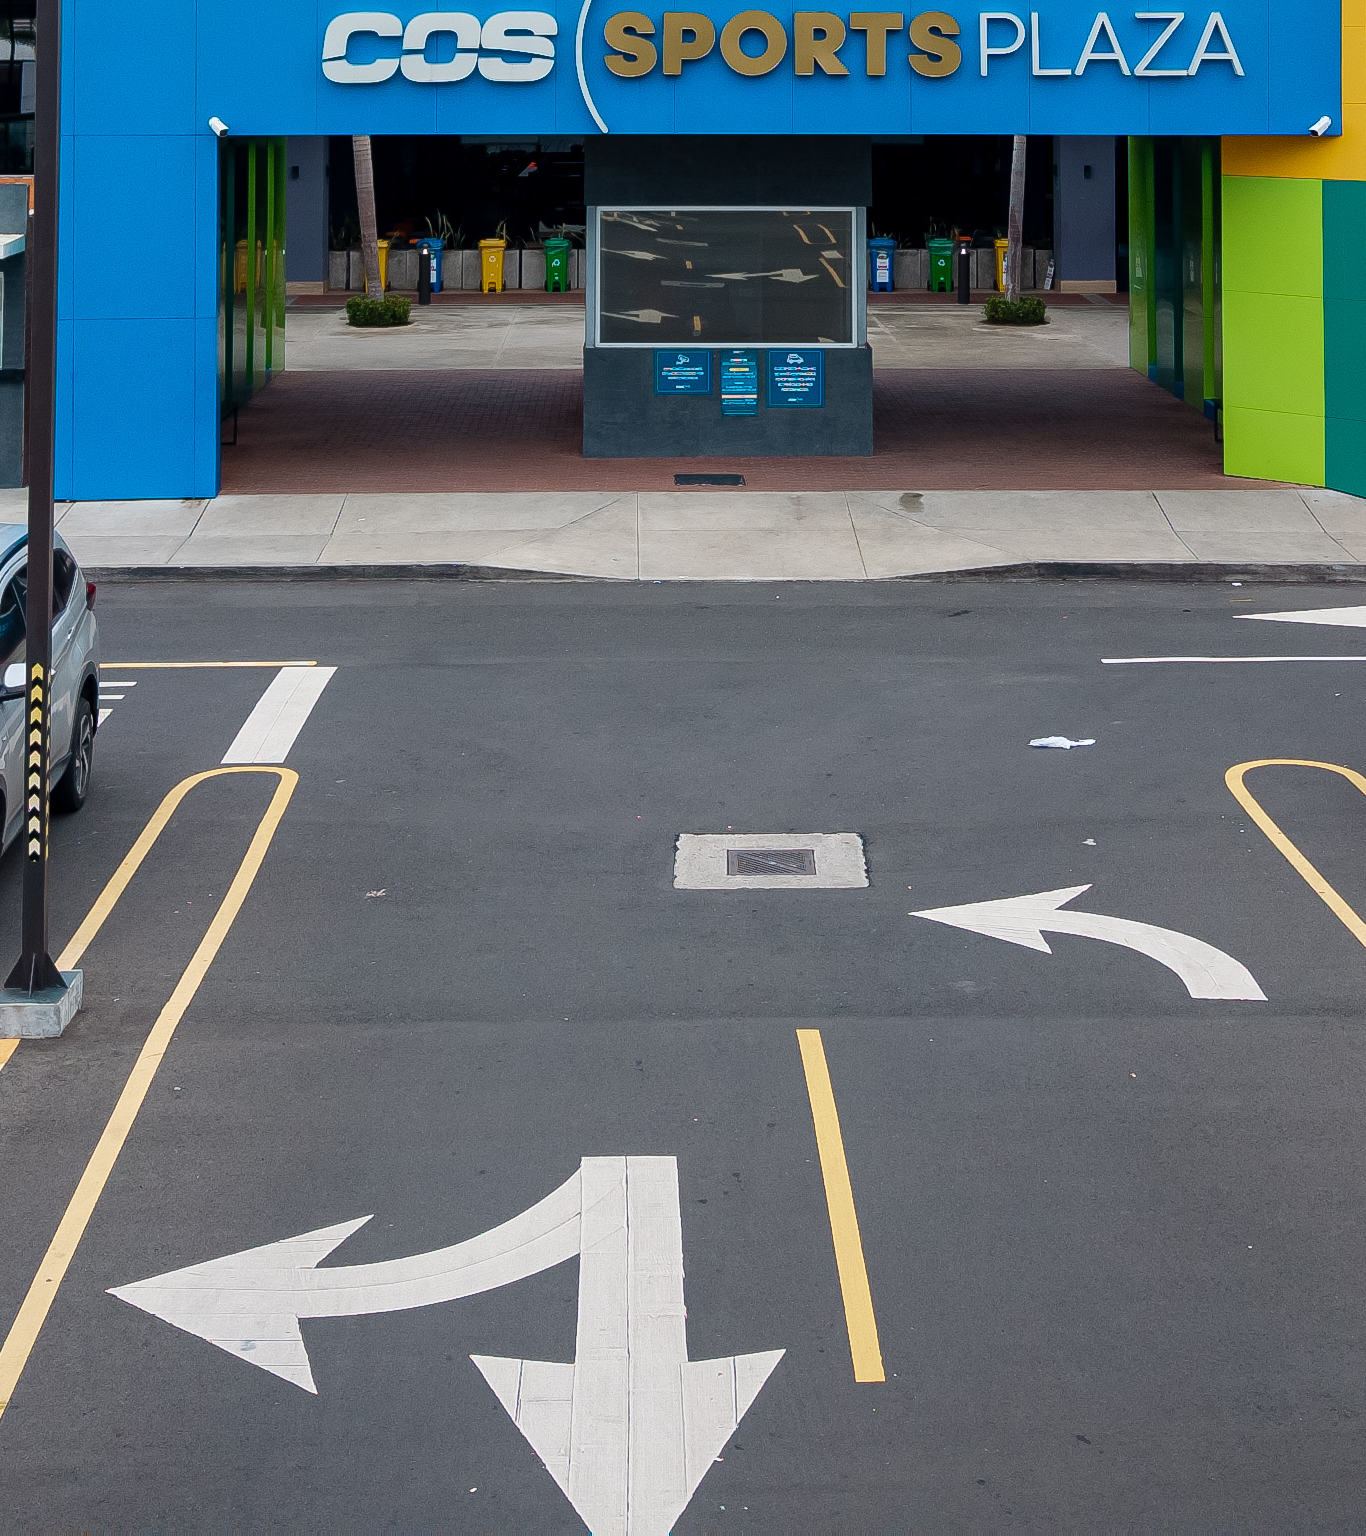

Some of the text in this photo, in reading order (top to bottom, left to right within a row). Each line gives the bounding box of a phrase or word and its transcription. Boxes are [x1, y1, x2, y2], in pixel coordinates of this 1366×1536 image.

[321, 9, 1245, 84] COS SPORTS PLAZA
